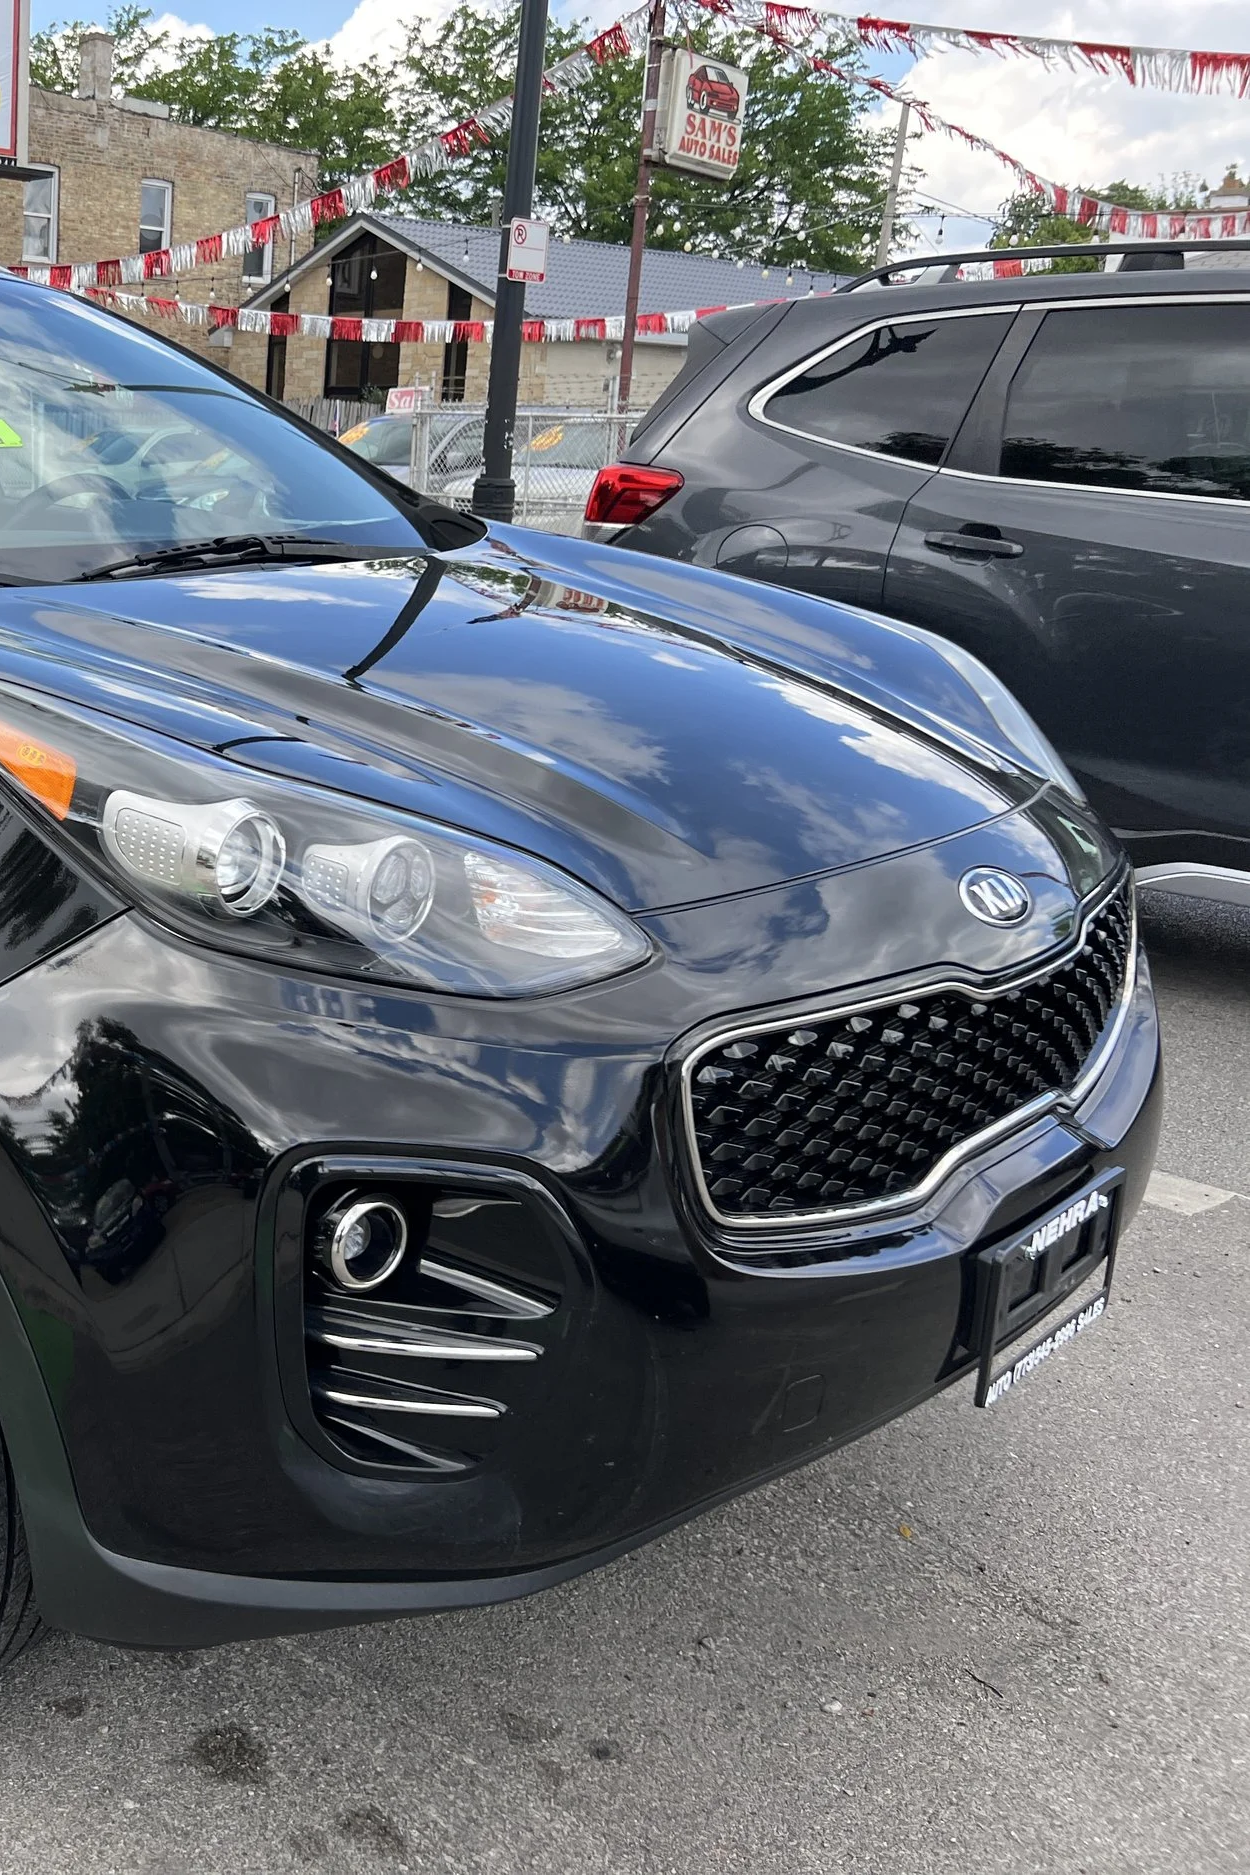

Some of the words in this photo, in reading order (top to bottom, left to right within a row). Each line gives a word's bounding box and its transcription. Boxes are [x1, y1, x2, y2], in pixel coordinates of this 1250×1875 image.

[685, 112, 737, 148] SAM'S
[678, 135, 707, 158] AUTO
[708, 144, 739, 167] SALES
[1031, 1190, 1100, 1252] NEHRA
[984, 1370, 1012, 1408] AUTO
